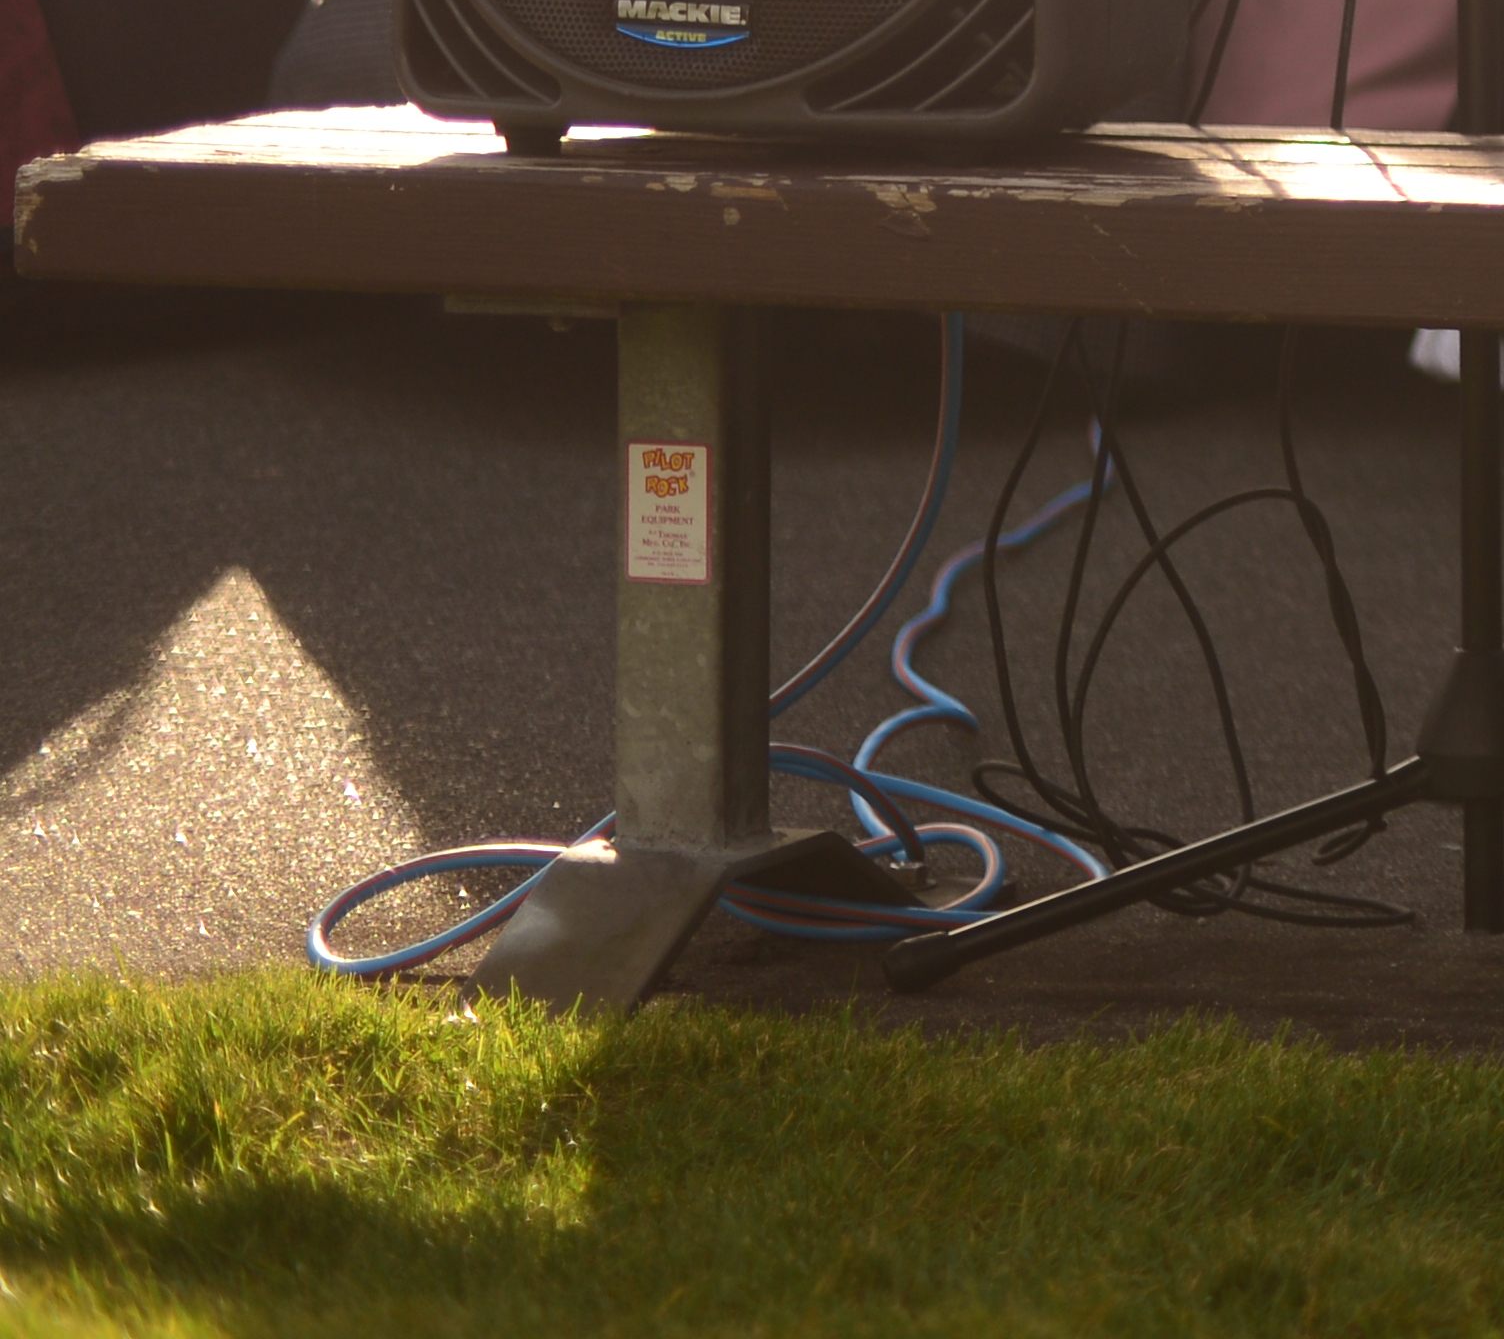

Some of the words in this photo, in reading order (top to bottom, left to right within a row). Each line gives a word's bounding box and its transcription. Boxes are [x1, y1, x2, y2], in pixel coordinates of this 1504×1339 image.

[655, 29, 707, 42] ACTIVE
[642, 448, 695, 472] PILOT
[645, 474, 689, 498] ROCK
[655, 504, 681, 514] PARK
[641, 515, 694, 526] EQUIPMENT
